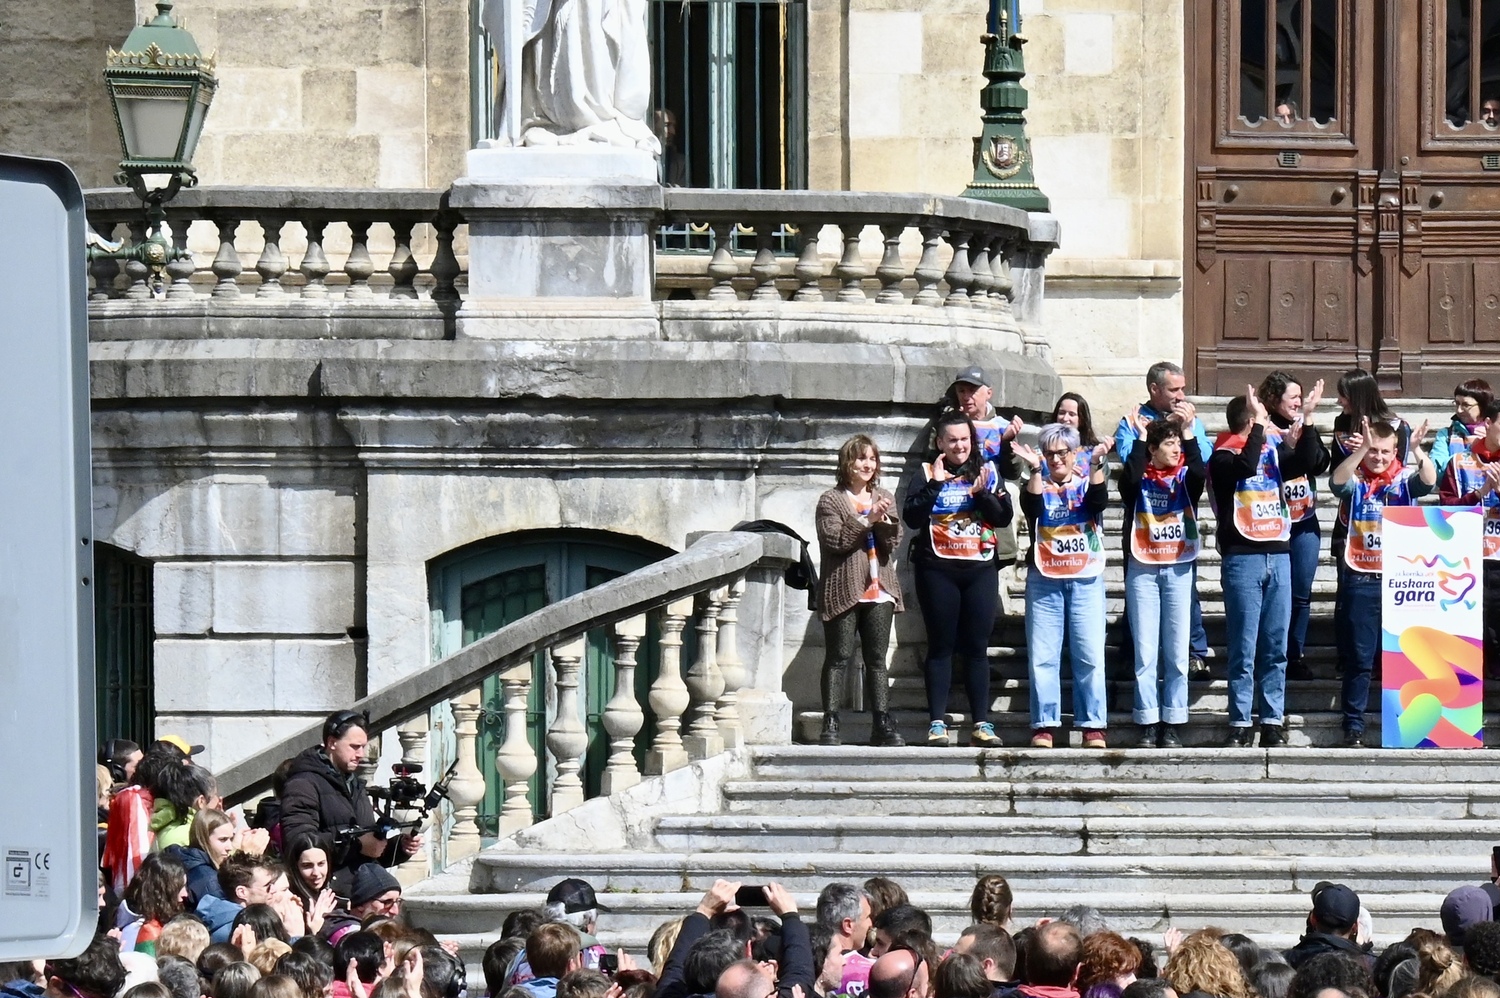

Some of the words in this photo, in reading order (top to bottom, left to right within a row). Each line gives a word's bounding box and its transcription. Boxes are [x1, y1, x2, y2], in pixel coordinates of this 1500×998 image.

[953, 521, 982, 535] 336
[1153, 525, 1182, 540] 3436
[1056, 538, 1086, 553] 3436
[1367, 534, 1382, 548] 34
[1388, 578, 1435, 588] Euskara
[1394, 590, 1435, 606] gara
